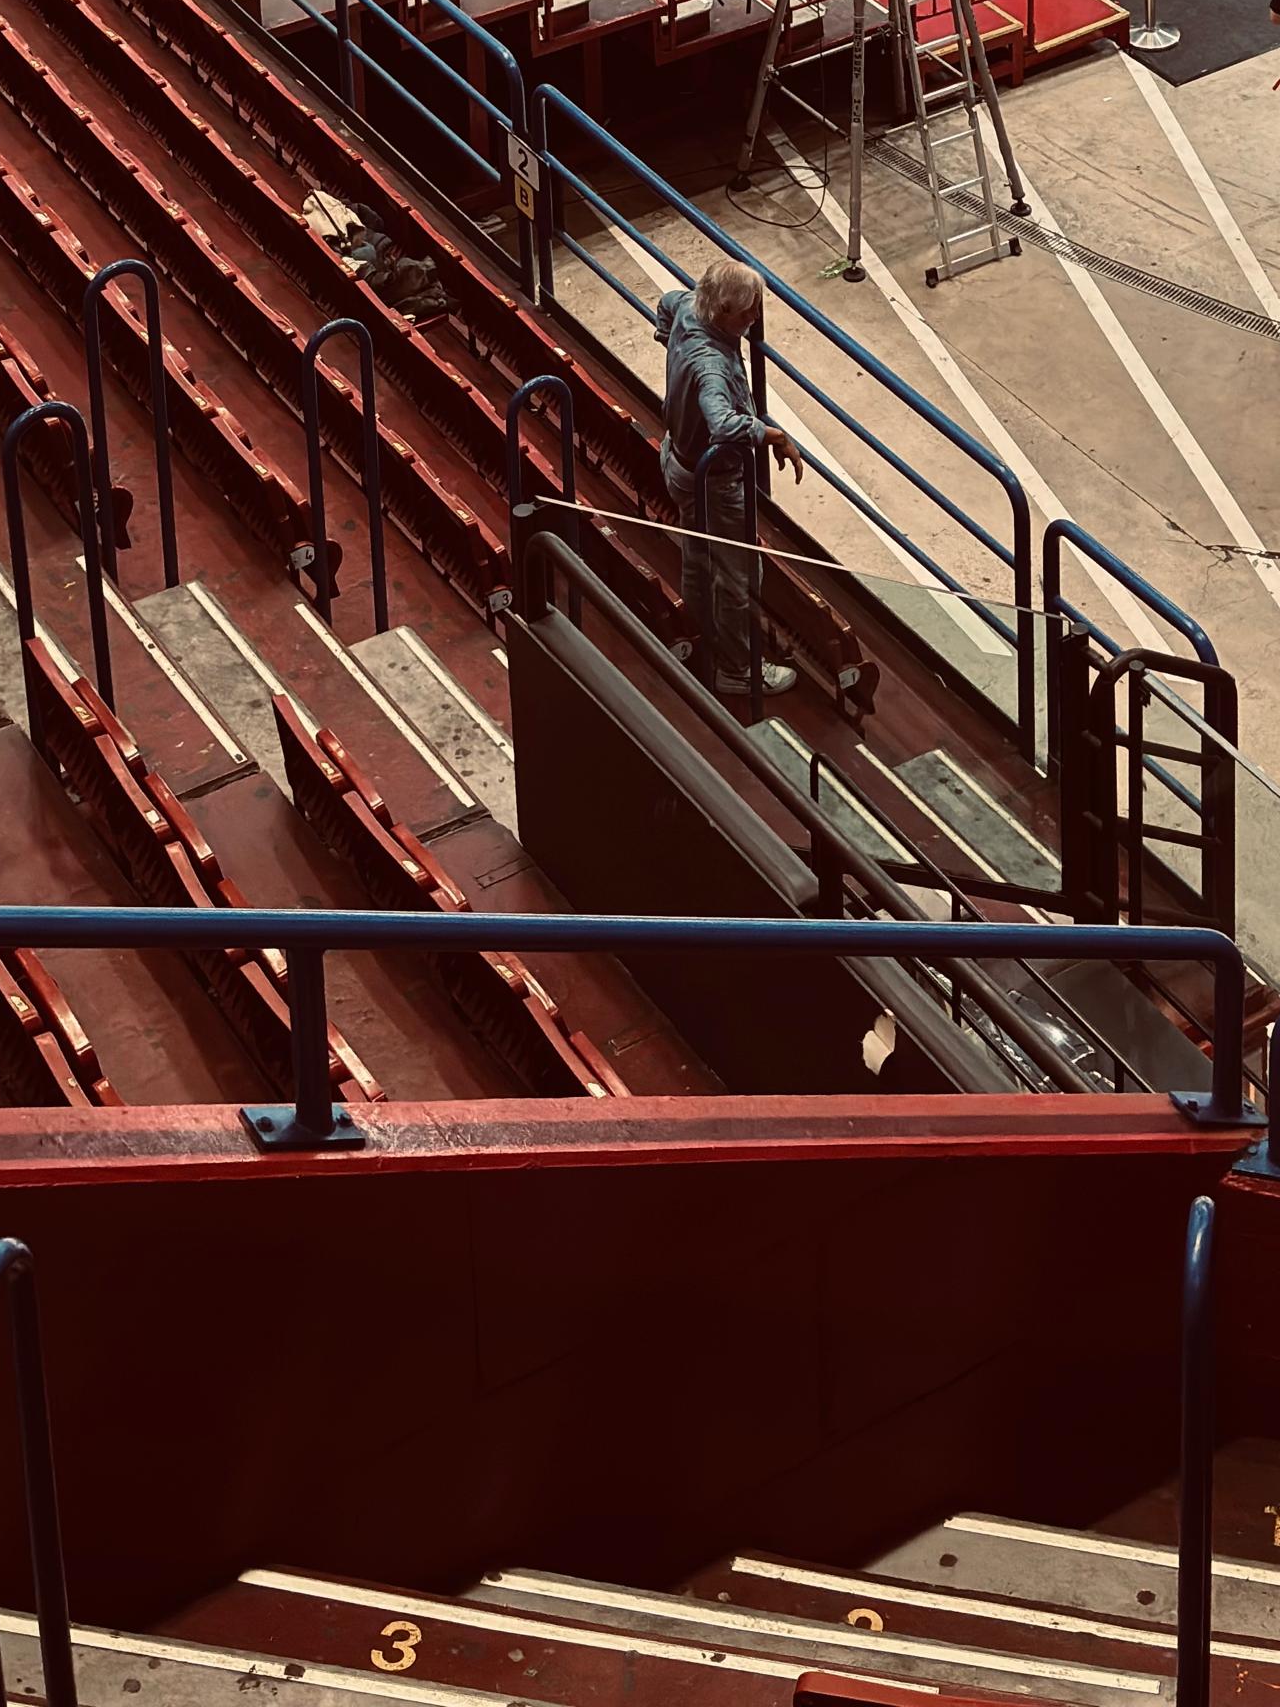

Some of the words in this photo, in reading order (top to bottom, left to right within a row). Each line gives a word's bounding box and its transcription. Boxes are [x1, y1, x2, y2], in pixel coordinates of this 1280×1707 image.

[517, 147, 529, 178] 2
[519, 187, 529, 207] B
[370, 1620, 423, 1672] 3
